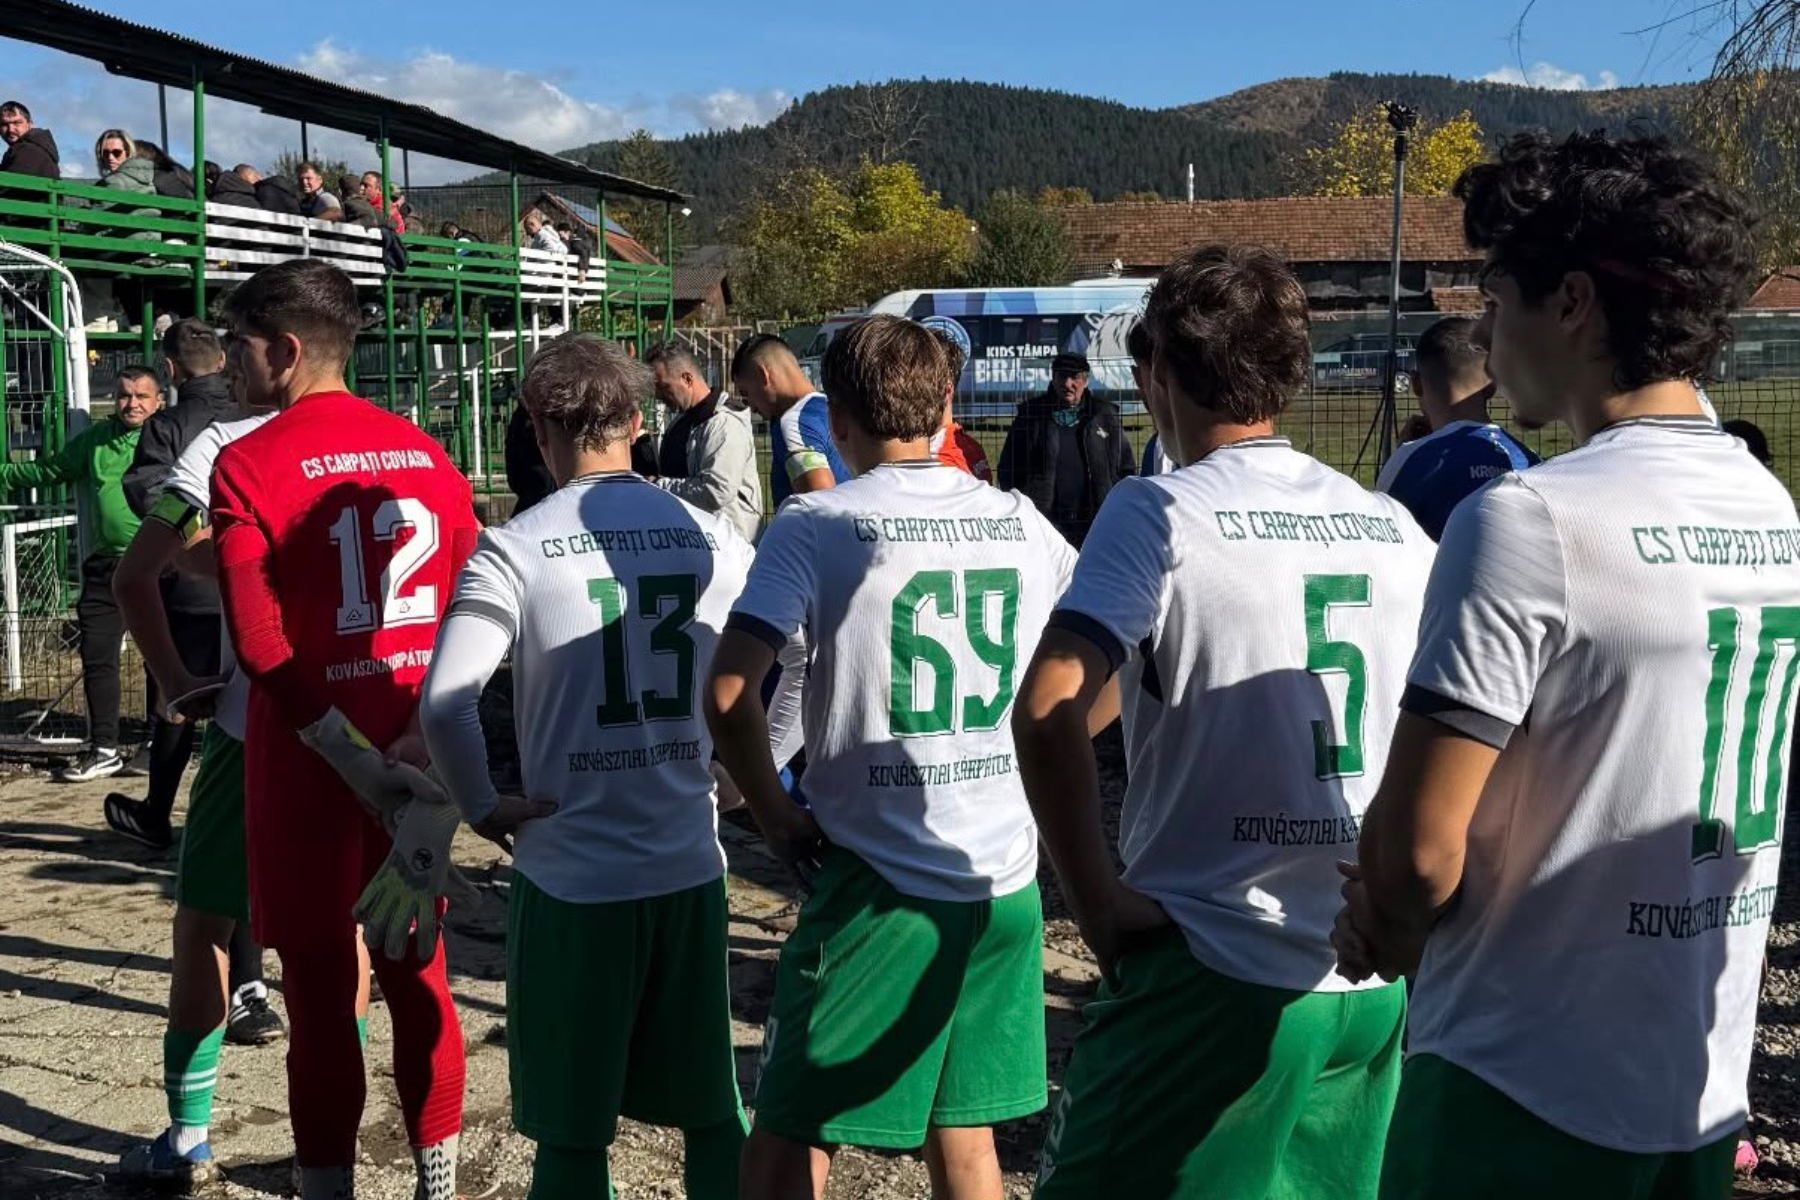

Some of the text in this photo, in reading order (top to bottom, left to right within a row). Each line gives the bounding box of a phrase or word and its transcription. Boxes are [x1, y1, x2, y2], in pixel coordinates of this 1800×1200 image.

[986, 343, 1059, 357] KIDS TÂMPA
[301, 457, 325, 480] CS
[323, 451, 381, 477] CARPAȚI
[541, 527, 720, 558] CS CARPAȚI COVASNA
[854, 517, 1027, 548] CS CARPAȚI COVASNA
[1214, 511, 1247, 541] CS
[1247, 511, 1336, 549] CARPAȚI
[1631, 526, 1676, 564] CS
[329, 498, 439, 635] 12
[586, 574, 699, 728] 13
[889, 567, 1022, 738] 69
[1303, 573, 1372, 781] 5
[1692, 606, 1800, 865] 10
[568, 748, 648, 772] KOVÁSZNAI
[868, 760, 951, 787] KOVÁSZNAI
[1233, 813, 1338, 846] KOVÁSZNAI
